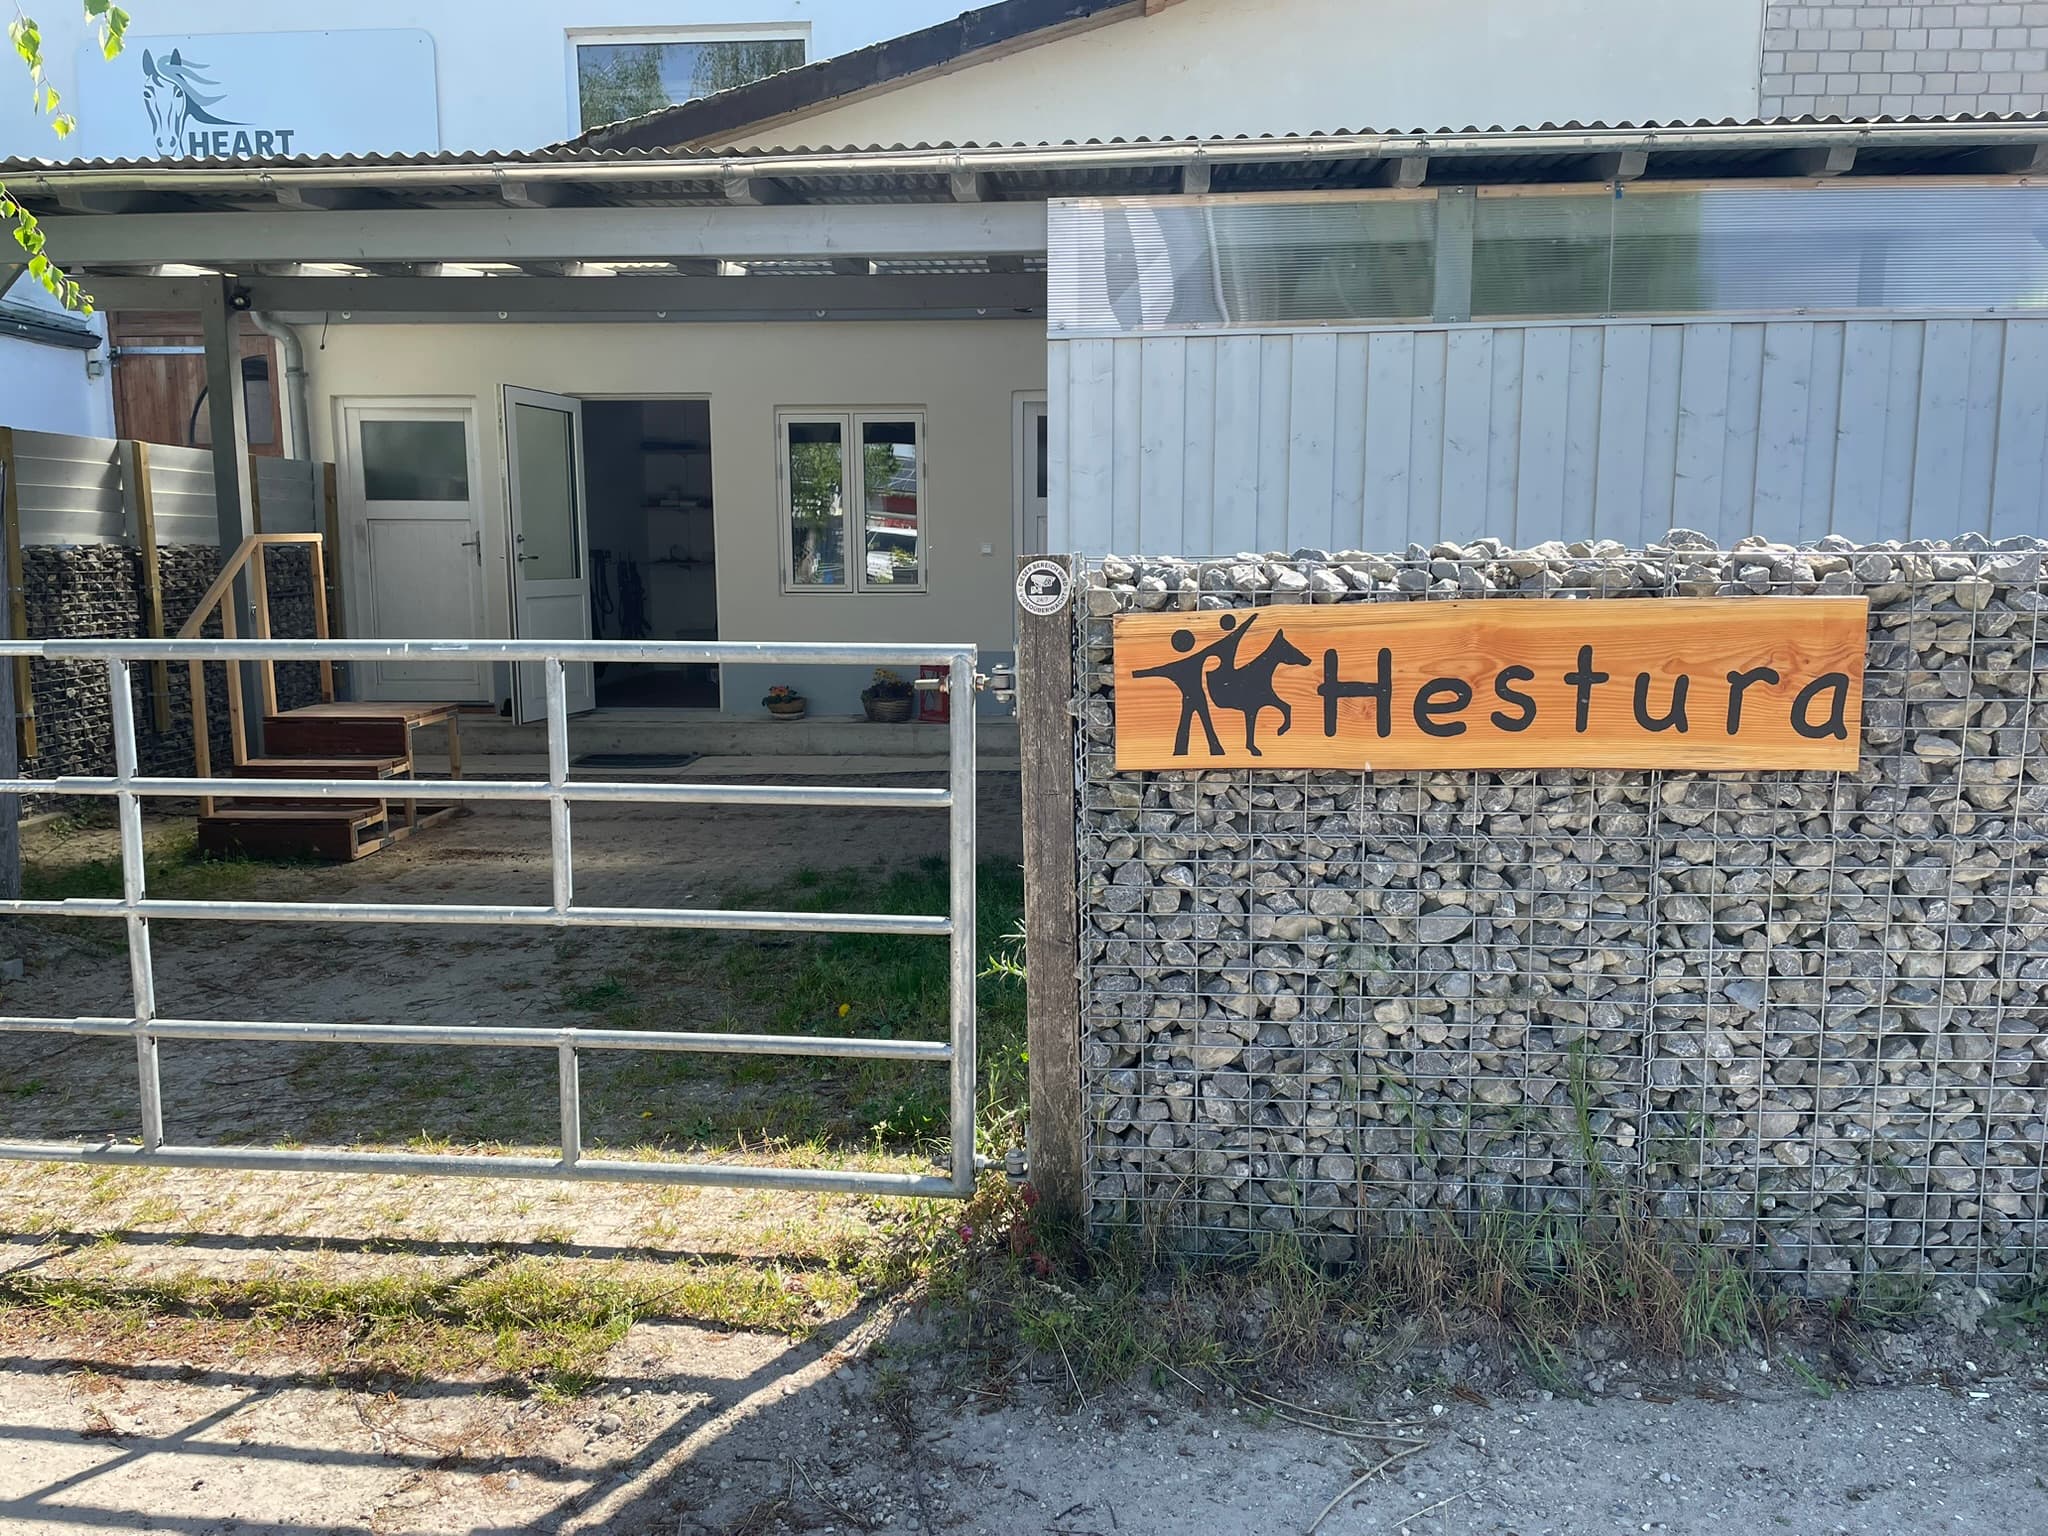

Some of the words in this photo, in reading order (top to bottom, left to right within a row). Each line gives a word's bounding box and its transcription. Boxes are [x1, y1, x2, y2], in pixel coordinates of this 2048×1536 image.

[188, 129, 295, 157] HEART
[1018, 566, 1032, 587] DIESER
[1032, 562, 1059, 572] BEREICH
[1317, 644, 1849, 740] Hestura
